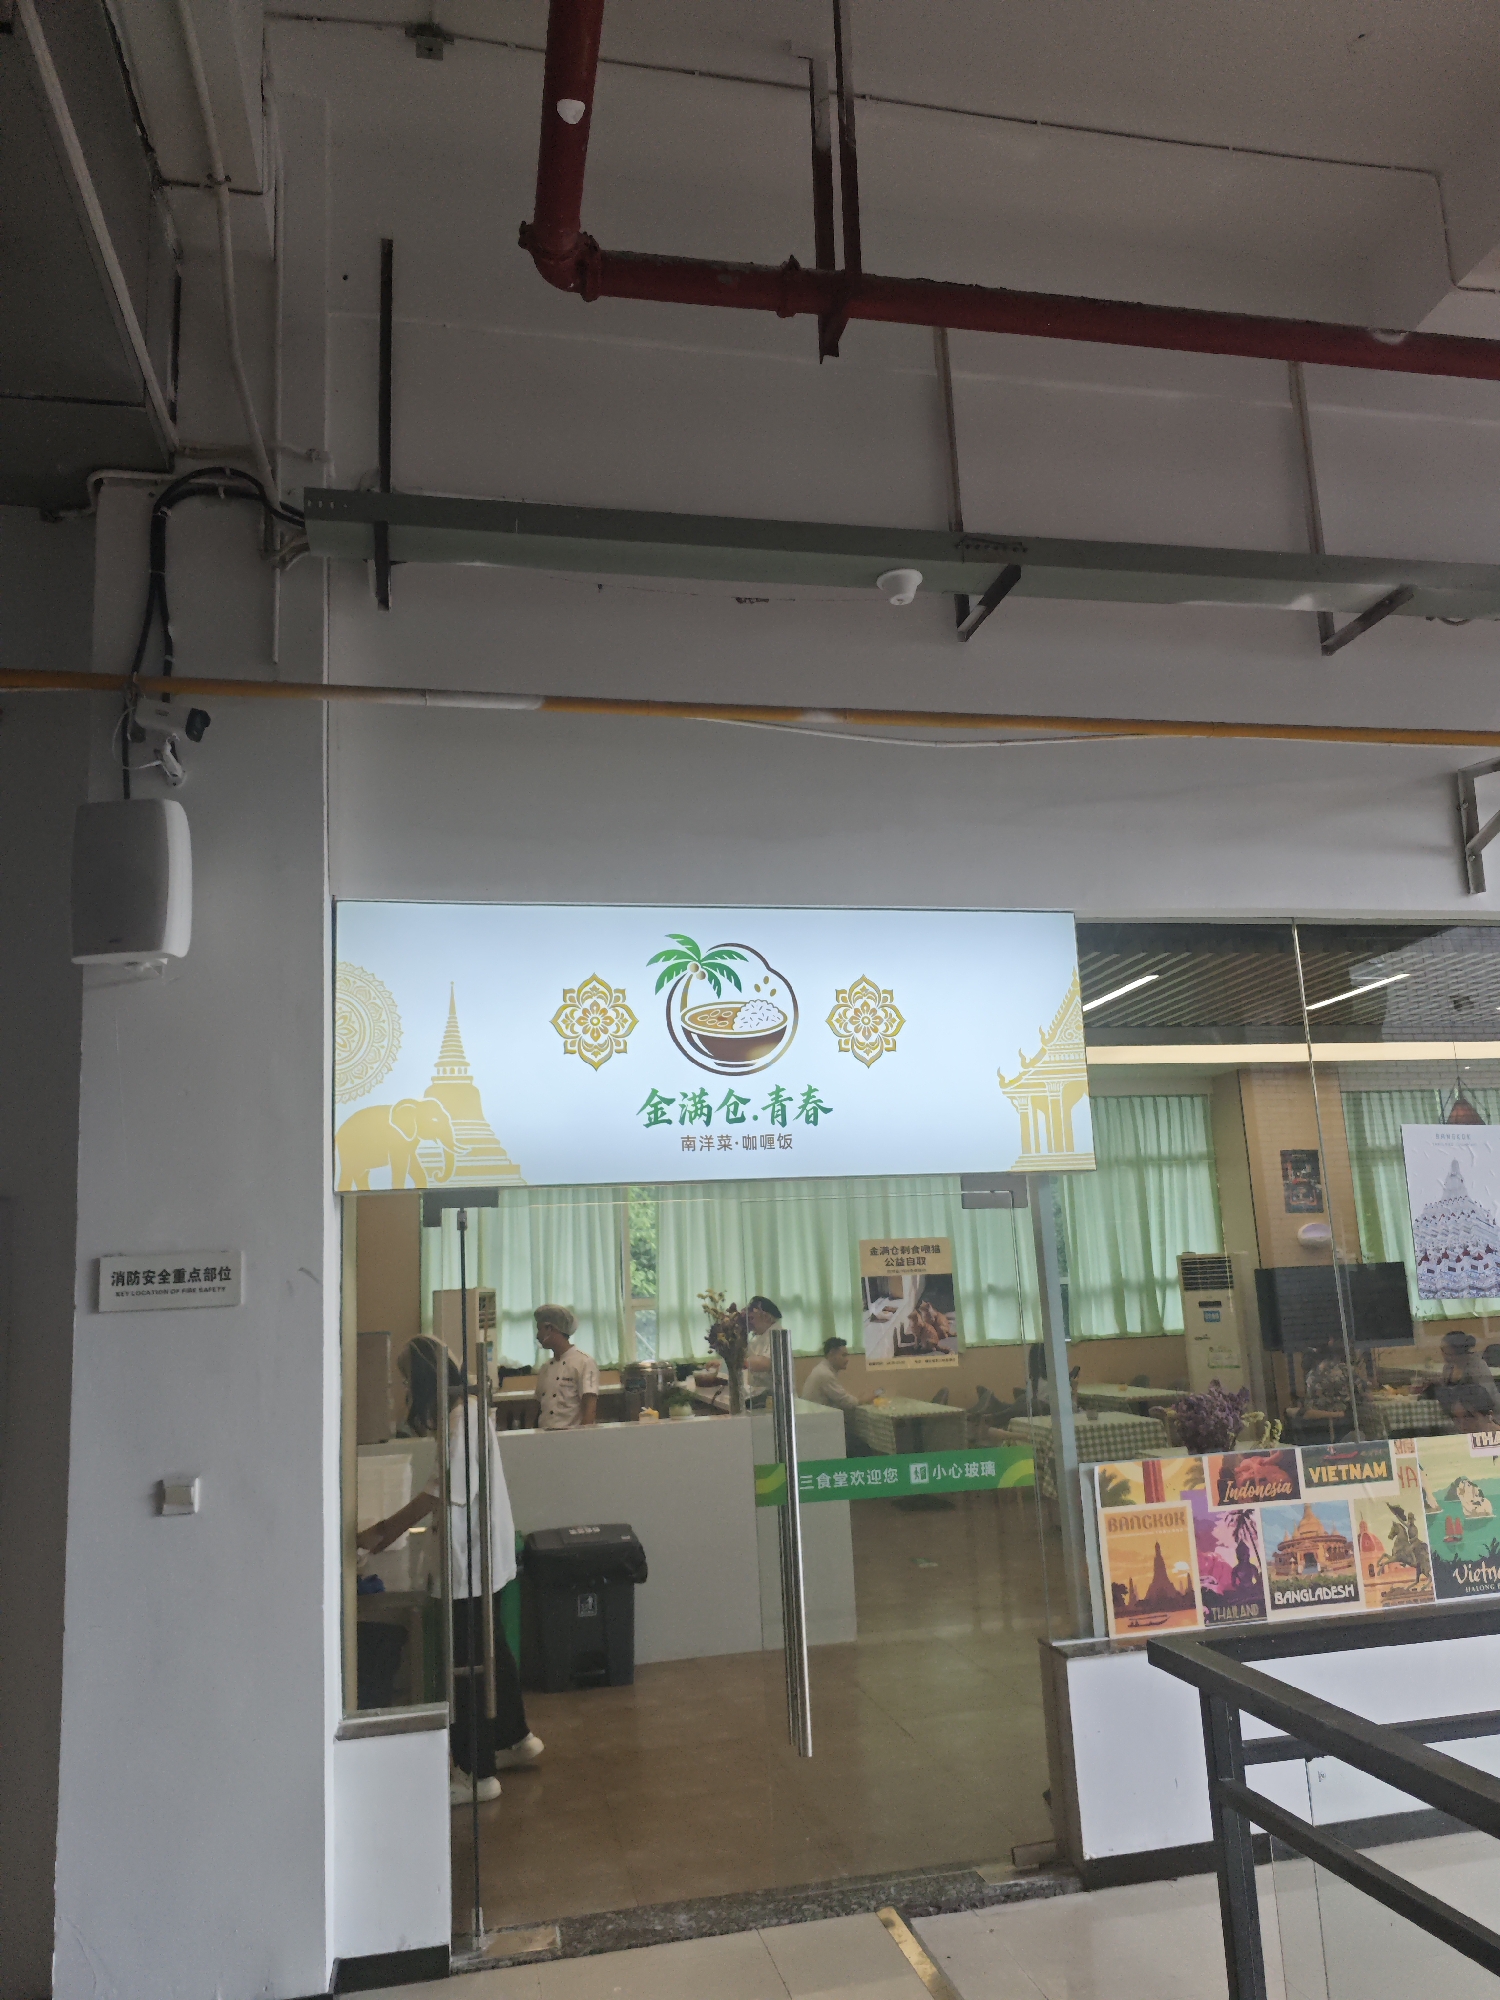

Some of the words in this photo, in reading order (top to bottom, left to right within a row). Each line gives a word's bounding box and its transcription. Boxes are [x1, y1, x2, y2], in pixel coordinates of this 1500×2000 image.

[884, 1256, 926, 1267] 公益自取
[111, 1266, 231, 1286] 消防安全重点部位
[131, 1288, 169, 1296] LOCATION
[799, 1467, 898, 1490] 三食堂欢迎您
[932, 1460, 996, 1480] 小心玻璃
[1308, 1460, 1388, 1483] VIETNAM
[1223, 1479, 1292, 1502] Indonesia
[1108, 1511, 1185, 1532] BANGKOK
[1274, 1584, 1355, 1605] BANGLADESH
[1465, 1584, 1495, 1593] HALONG
[1212, 1603, 1259, 1621] THAILAND
